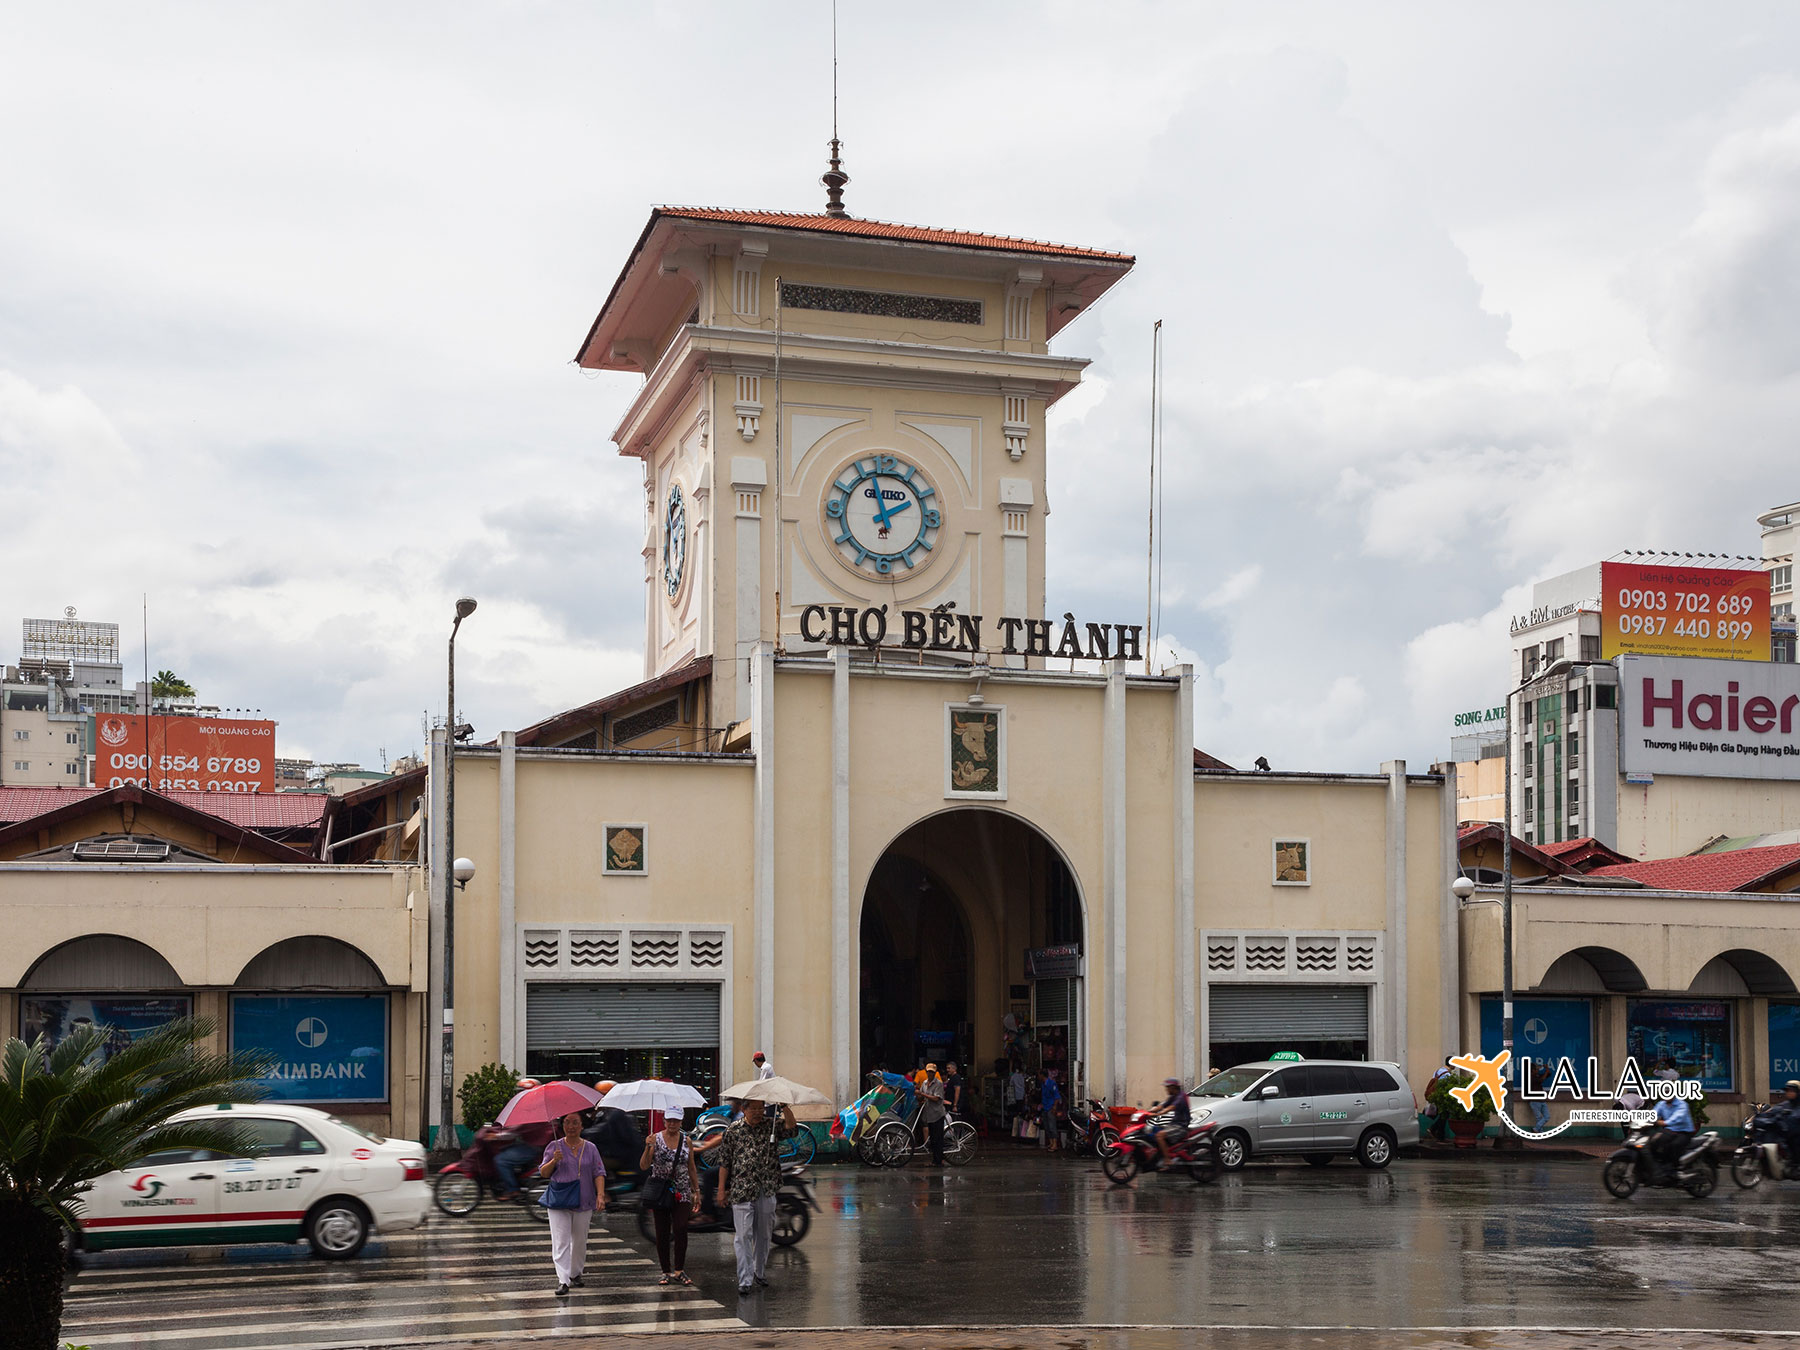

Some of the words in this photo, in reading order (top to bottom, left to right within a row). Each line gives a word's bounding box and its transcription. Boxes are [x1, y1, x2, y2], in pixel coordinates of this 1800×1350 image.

[872, 455, 898, 474] 12
[826, 499, 843, 518] 9
[924, 509, 940, 528] 3
[875, 557, 891, 574] 6
[1639, 572, 1659, 583] Liên
[1660, 574, 1674, 584] Hệ
[1677, 574, 1710, 587] Quảng
[1712, 575, 1734, 587] Cáo
[1619, 588, 1667, 611] 0903
[1675, 592, 1710, 613] 702
[1716, 595, 1753, 615] 689
[800, 604, 888, 651] CHỢ
[902, 600, 983, 652] BẾN
[996, 612, 1143, 660] THÀNH
[1510, 615, 1519, 632] A
[1619, 614, 1667, 636] 0987
[1673, 618, 1710, 639] 440
[1716, 620, 1753, 640] 899
[1643, 677, 1800, 734] Haier
[1454, 710, 1482, 727] SONG
[199, 725, 217, 735] MỜI
[218, 725, 250, 736] QUẢNG
[252, 727, 271, 736] CÁO
[1643, 739, 1677, 752] Thương
[1679, 741, 1698, 753] Hiệu
[1699, 742, 1719, 754] Điện
[1720, 743, 1735, 753] Gia
[1736, 744, 1759, 756] Dụng
[1760, 745, 1782, 757] Hàng
[1783, 744, 1800, 756] Đầu
[110, 753, 152, 770] 090
[159, 755, 200, 772] 554
[206, 757, 261, 774] 6789
